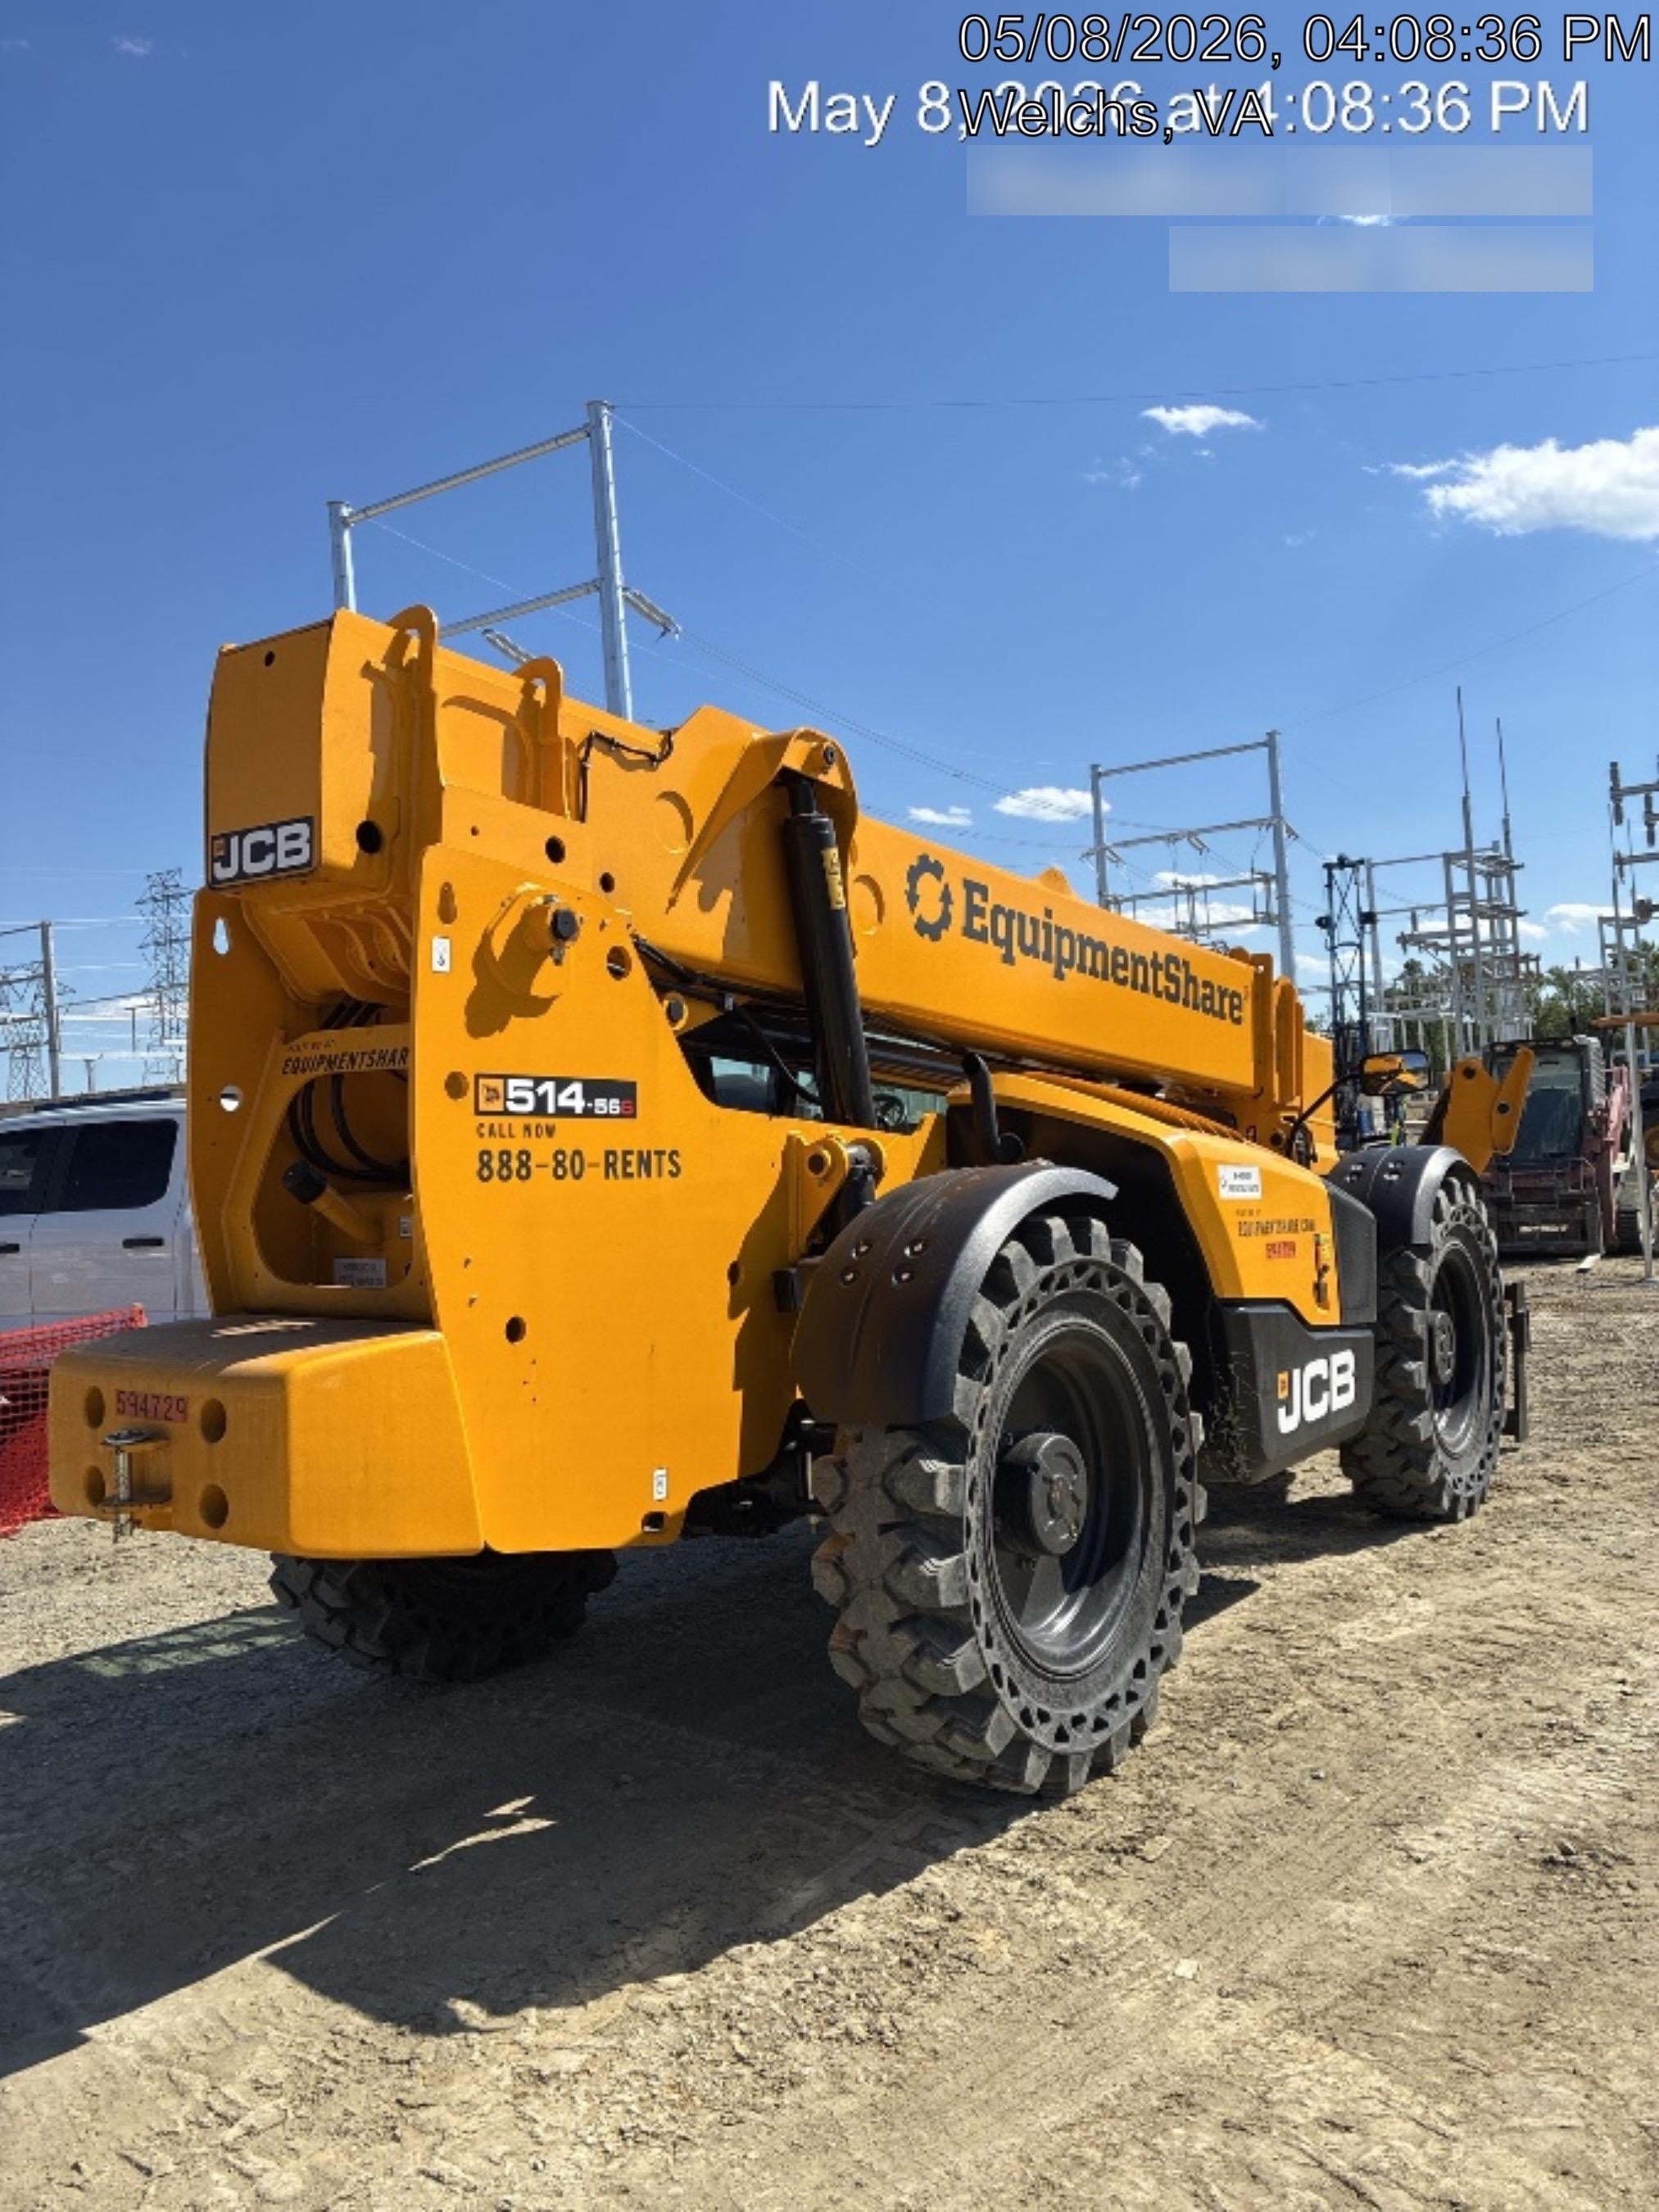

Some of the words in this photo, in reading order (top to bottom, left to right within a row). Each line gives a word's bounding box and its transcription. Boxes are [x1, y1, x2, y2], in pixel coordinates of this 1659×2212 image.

[213, 822, 311, 881] JCB
[962, 877, 1243, 1026] EquipmentShare
[477, 1122, 517, 1139] CALL
[523, 1122, 556, 1139] NOW
[476, 1149, 682, 1183] 888-80-RENTS
[1278, 1349, 1356, 1434] JCB
